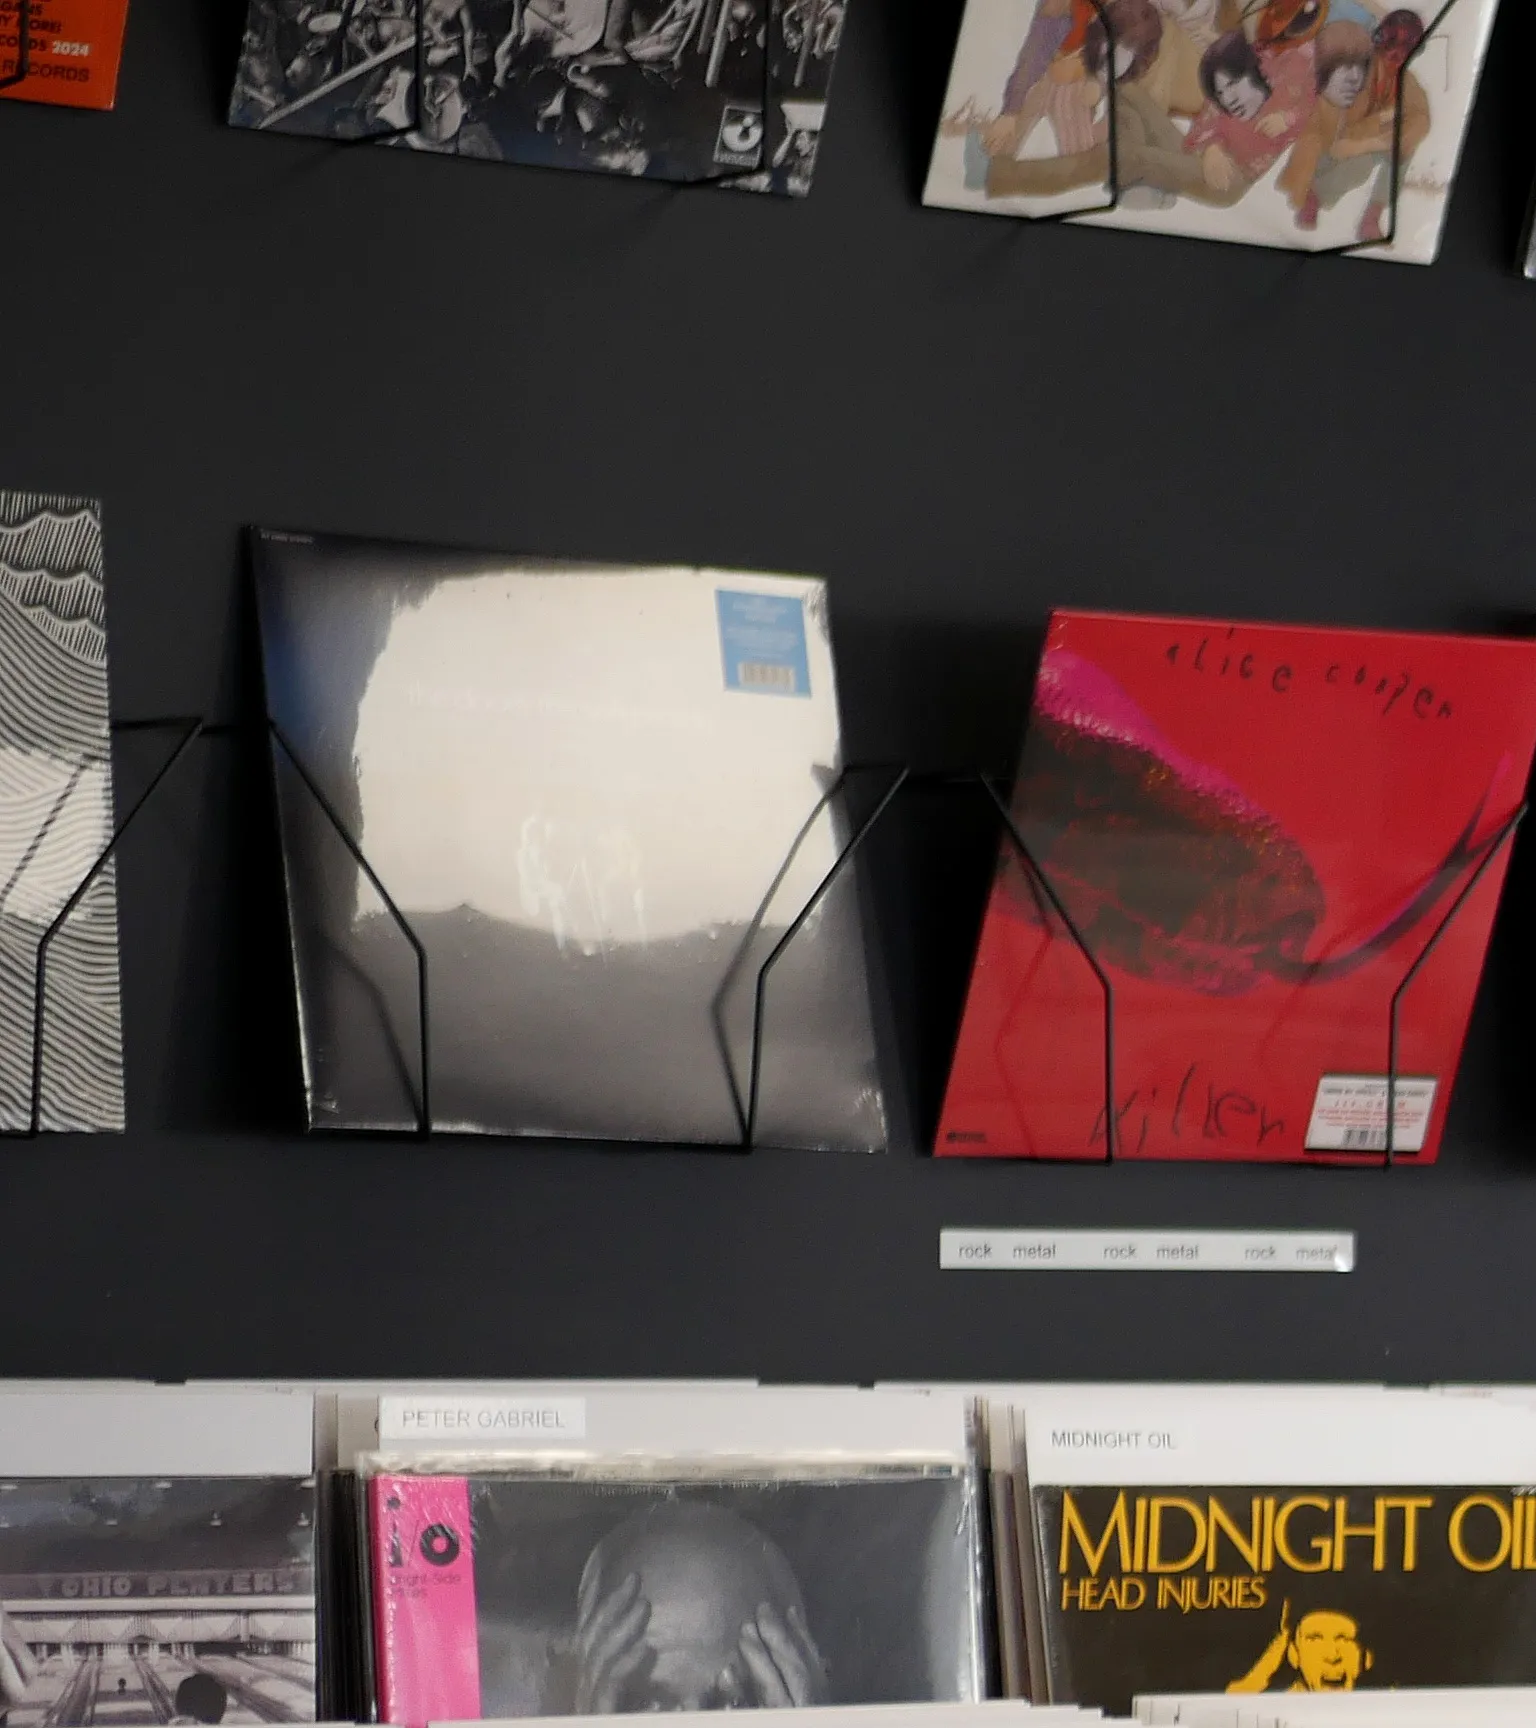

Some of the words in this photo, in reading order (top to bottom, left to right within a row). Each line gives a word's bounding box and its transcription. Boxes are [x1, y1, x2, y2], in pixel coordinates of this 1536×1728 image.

[52, 40, 89, 57] 2024
[957, 1242, 994, 1261] rock
[1012, 1242, 1057, 1261] metal
[1103, 1243, 1138, 1261] rock
[1156, 1243, 1200, 1261] metal
[1244, 1244, 1278, 1262] rock
[402, 1409, 471, 1429] PETER
[477, 1409, 566, 1429] GABRIEL
[1051, 1430, 1142, 1450] MIDNIGHT
[1147, 1431, 1178, 1451] OIL
[1058, 1488, 1433, 1578] MIDNIGHT
[1061, 1575, 1146, 1611] HEAD
[1157, 1575, 1268, 1616] INJURIES
